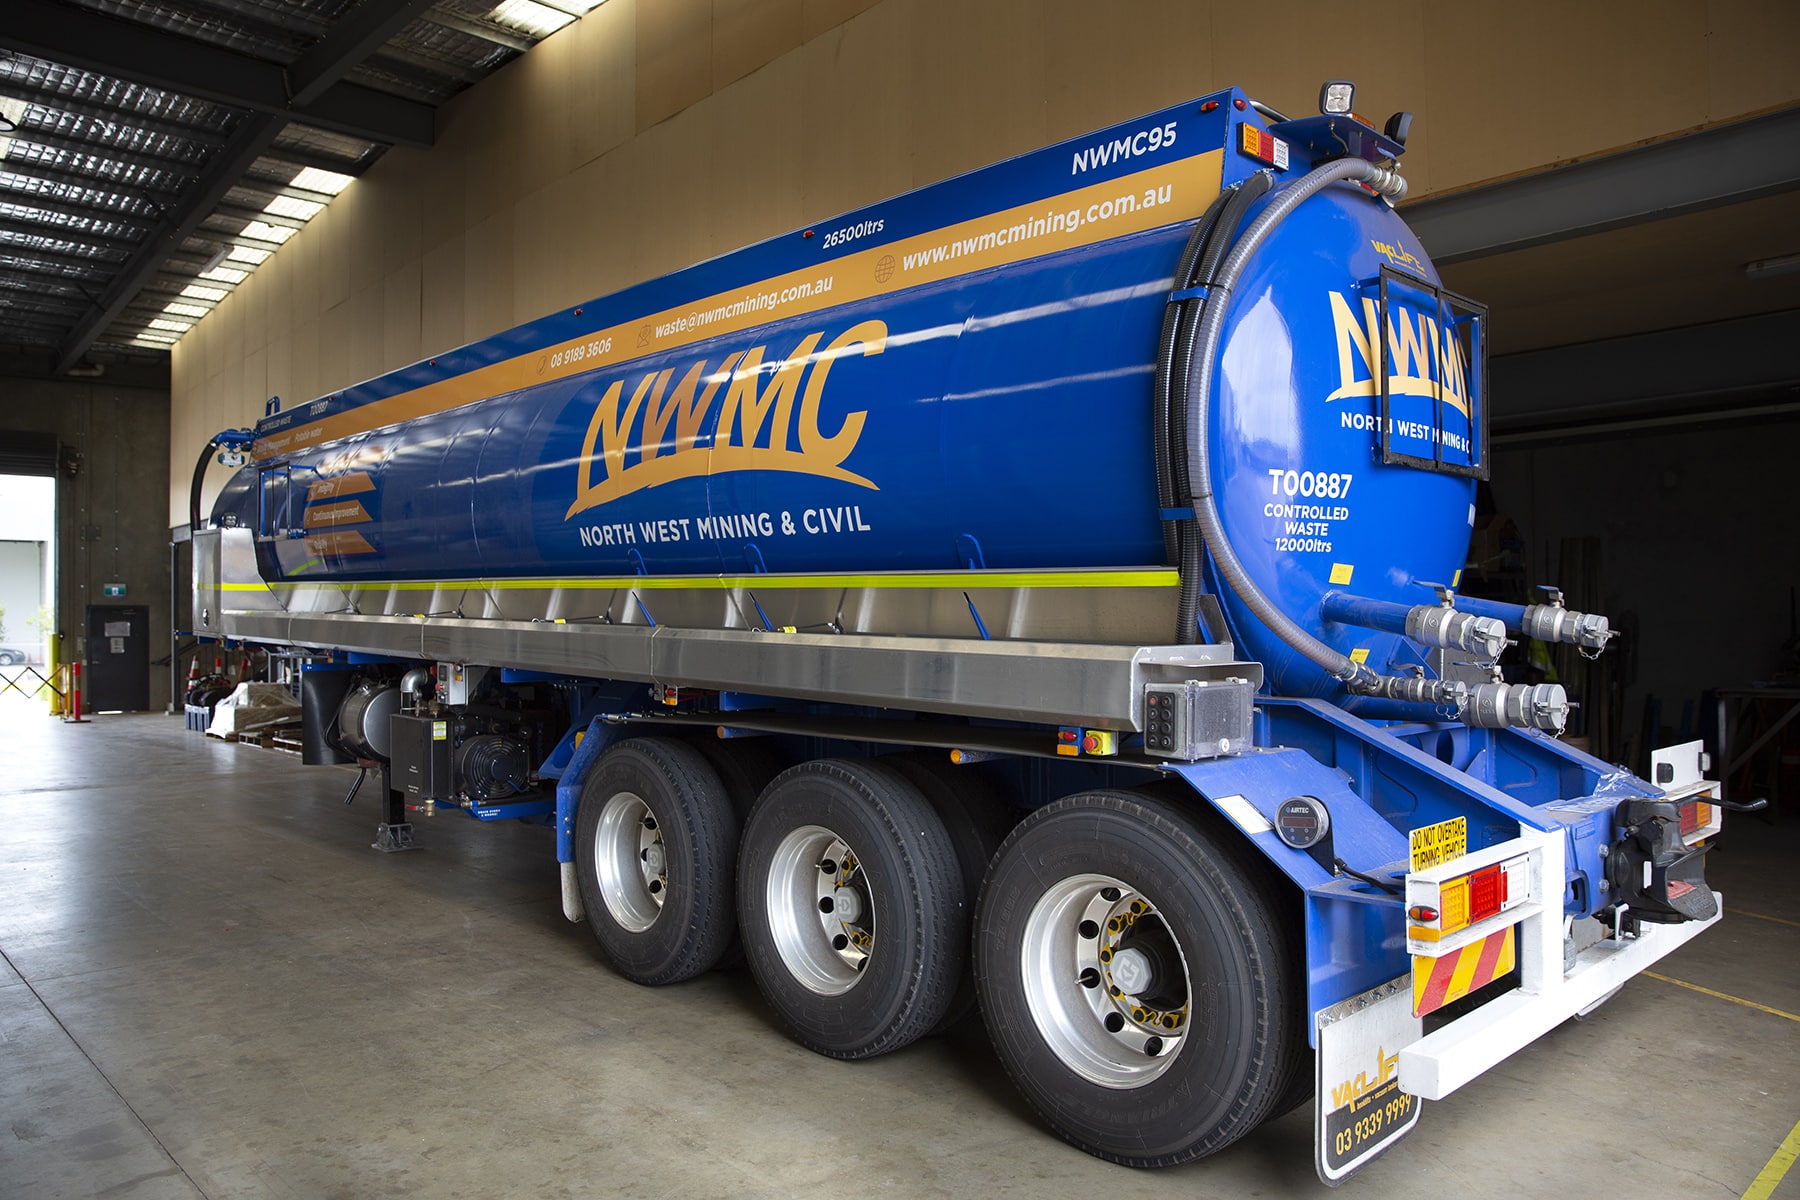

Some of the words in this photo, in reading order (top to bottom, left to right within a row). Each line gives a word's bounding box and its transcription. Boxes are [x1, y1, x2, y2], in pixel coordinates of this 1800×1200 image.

[1071, 121, 1177, 175] NWMC95
[822, 218, 885, 250] 26500ltrs
[903, 184, 1172, 272] www.nwmcmining.com.au
[655, 274, 833, 339] waste@nwmcmining.com.au
[550, 352, 564, 369] 08
[565, 345, 585, 364] 9189
[586, 337, 612, 360] 3606
[565, 320, 889, 521] NWMC
[1397, 419, 1430, 441] WEST
[1432, 427, 1461, 450] MNING
[579, 522, 636, 547] NORTH
[639, 519, 691, 544] WEST
[697, 512, 772, 541] MINING
[781, 510, 796, 536] &
[803, 505, 871, 534] CIVIL
[1264, 503, 1349, 521] CONTROLLED
[1275, 537, 1332, 553] 12000ltrs
[1285, 521, 1329, 537] WASTE
[1290, 806, 1310, 815] AIRTEC
[1413, 831, 1422, 850] DO
[1423, 826, 1435, 848] NOT
[1438, 818, 1465, 843] OVERTAKE
[1413, 846, 1440, 873] TURNING
[1441, 839, 1465, 864] VEHICLE
[1331, 1045, 1399, 1114] VACLIF
[1336, 1127, 1352, 1156] 03
[1355, 1108, 1383, 1145] 9339
[1385, 1093, 1412, 1125] 9999
